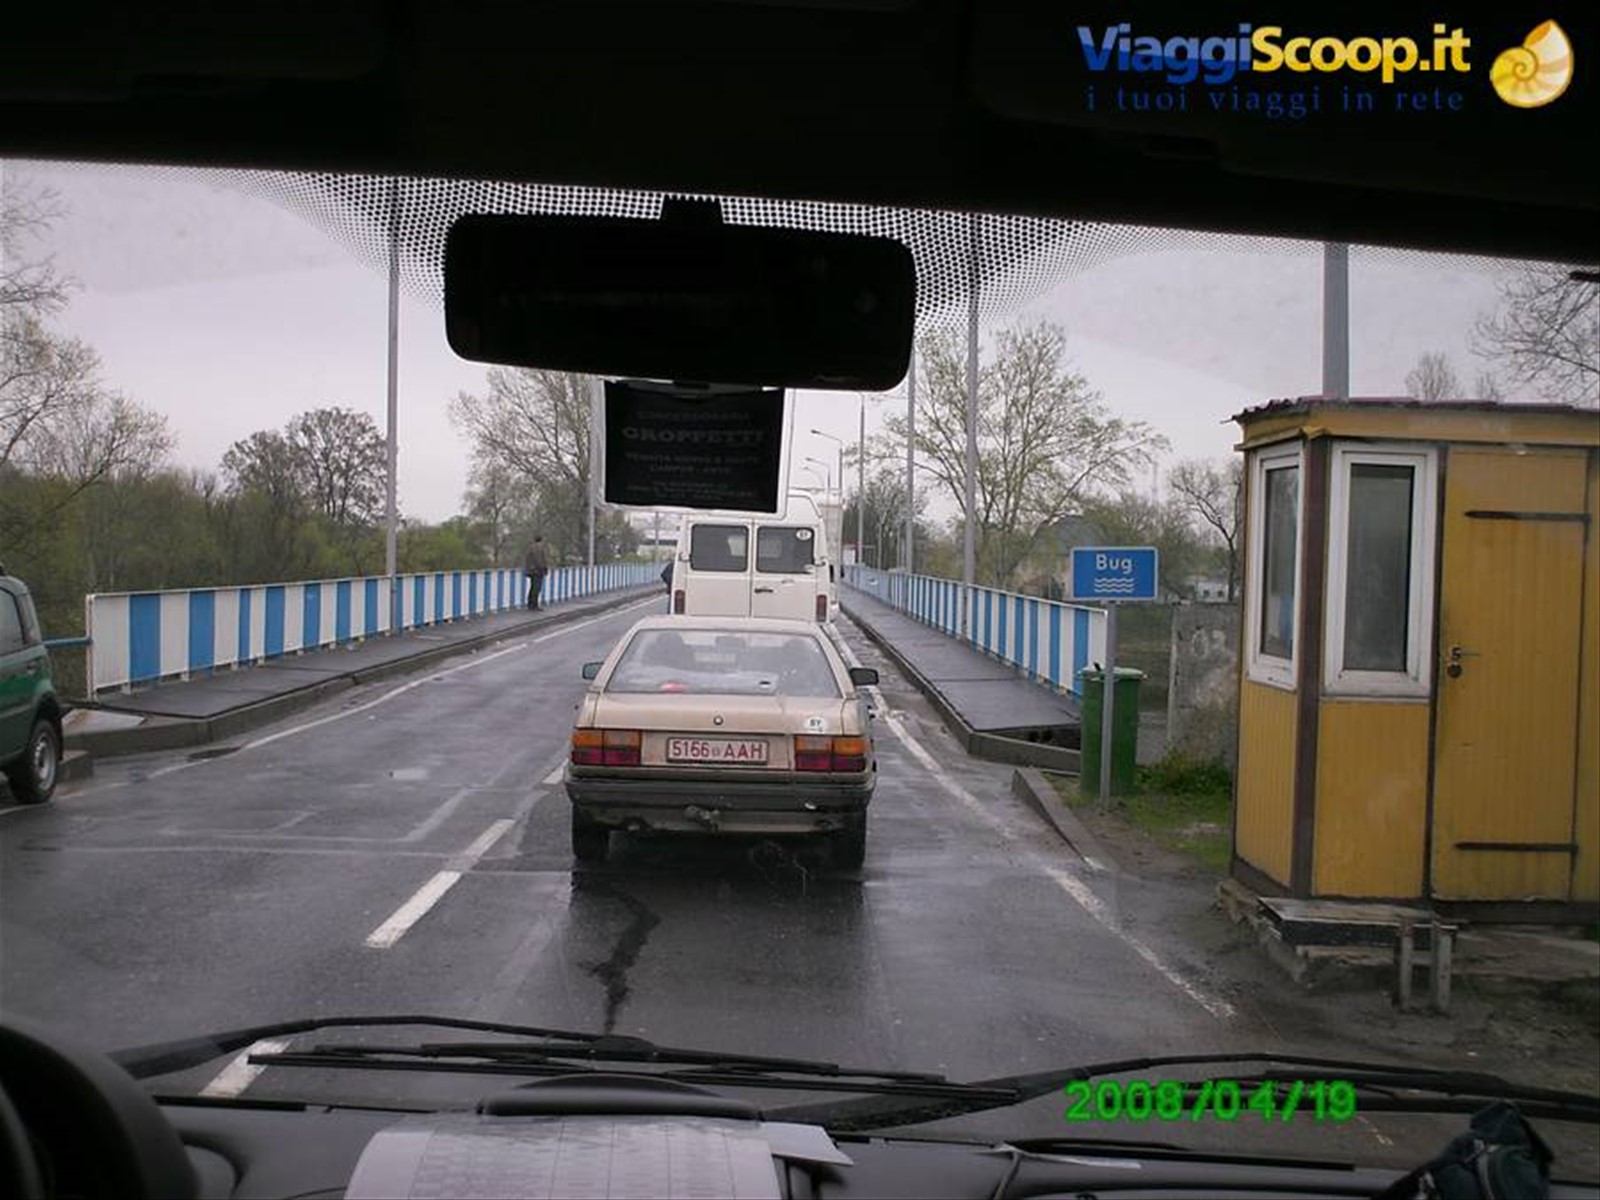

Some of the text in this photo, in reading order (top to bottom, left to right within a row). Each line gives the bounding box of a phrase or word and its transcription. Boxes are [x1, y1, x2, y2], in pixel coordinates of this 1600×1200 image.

[1096, 553, 1132, 574] Bug
[672, 740, 709, 757] 5166
[722, 742, 762, 759] AAH
